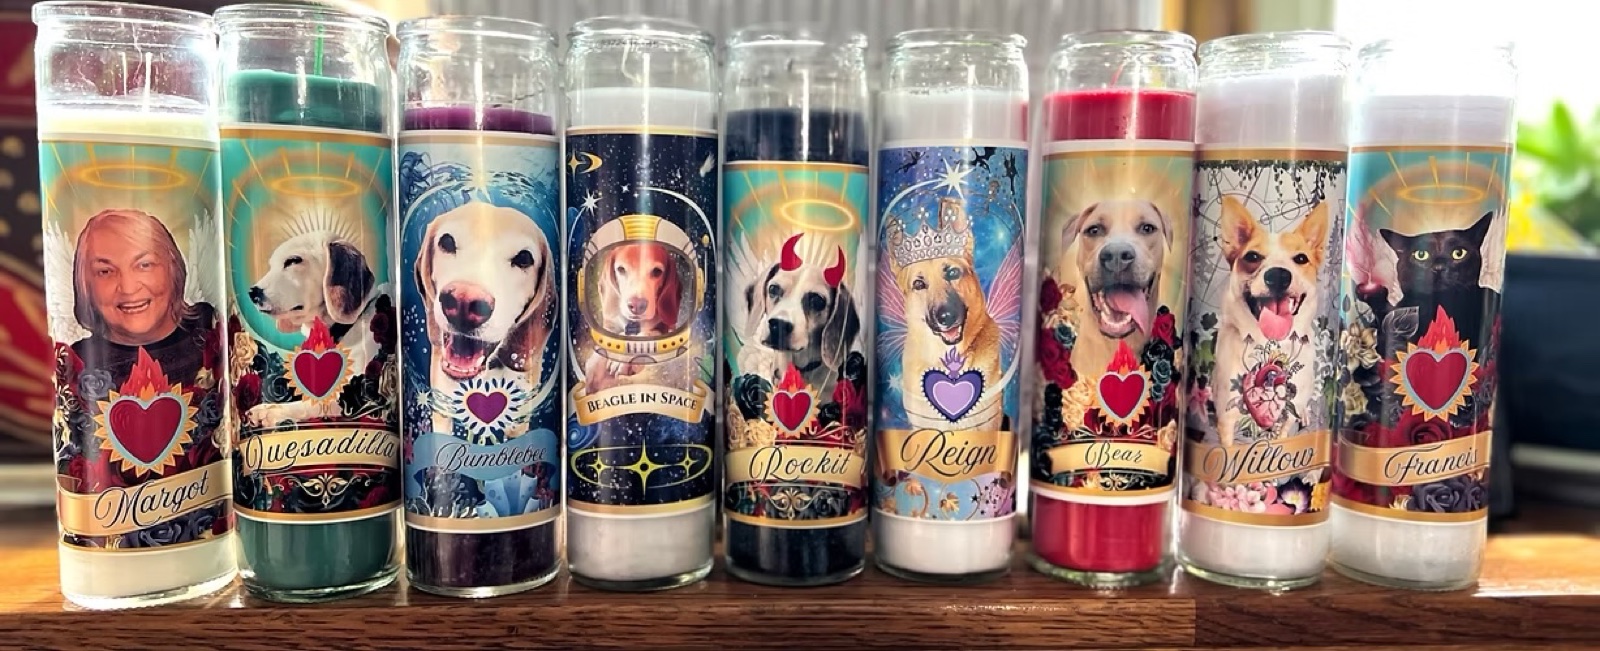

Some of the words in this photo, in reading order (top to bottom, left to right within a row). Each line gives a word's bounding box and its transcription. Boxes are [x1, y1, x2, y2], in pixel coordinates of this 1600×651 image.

[244, 428, 396, 475] Quesadilla
[435, 442, 547, 472] Bumblebee
[748, 445, 852, 485] Rockit
[901, 428, 998, 478] Reign
[1083, 440, 1142, 468] Bear
[1203, 440, 1315, 483] Willow
[1384, 443, 1480, 484] Francis
[94, 470, 210, 529] Margot
